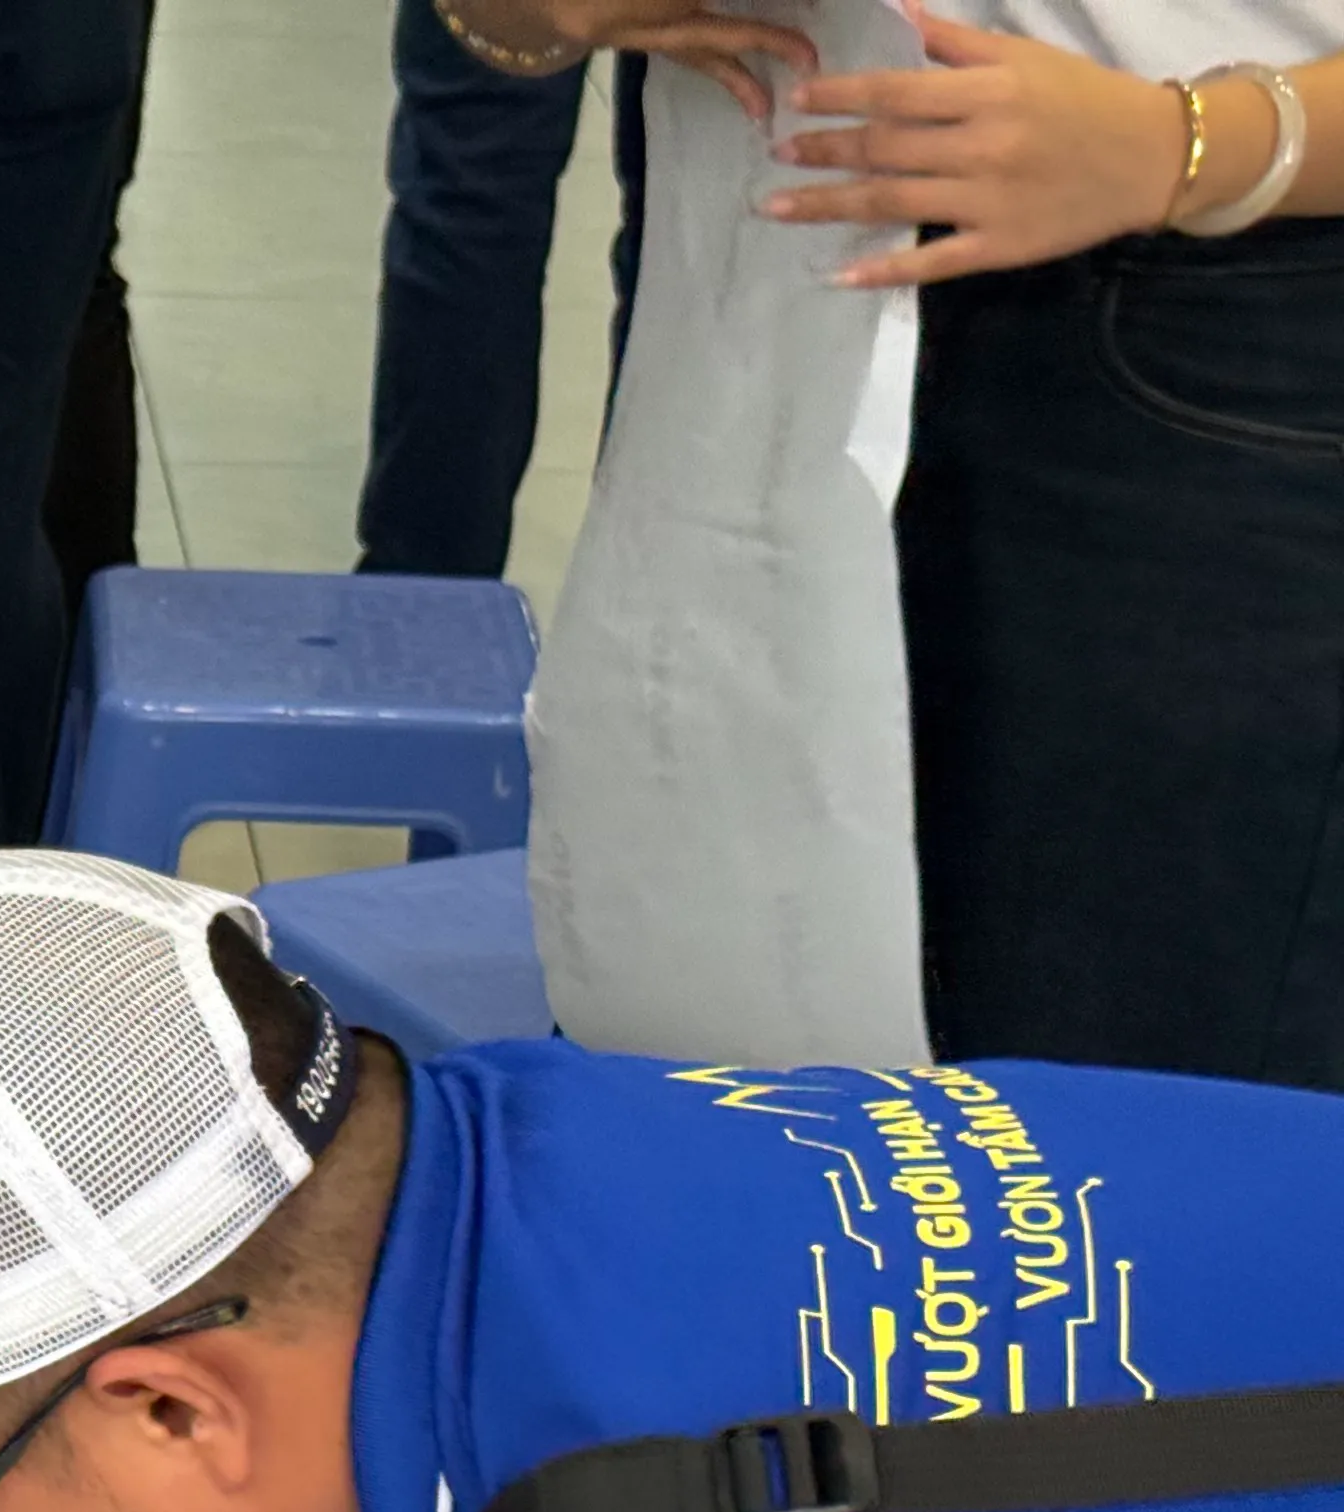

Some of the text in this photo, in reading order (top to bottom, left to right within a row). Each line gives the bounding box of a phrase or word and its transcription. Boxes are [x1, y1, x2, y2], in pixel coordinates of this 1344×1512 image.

[860, 1099, 990, 1422] VƯỢT GIỚI HẠN
[996, 1174, 1070, 1310] VƯƠN
